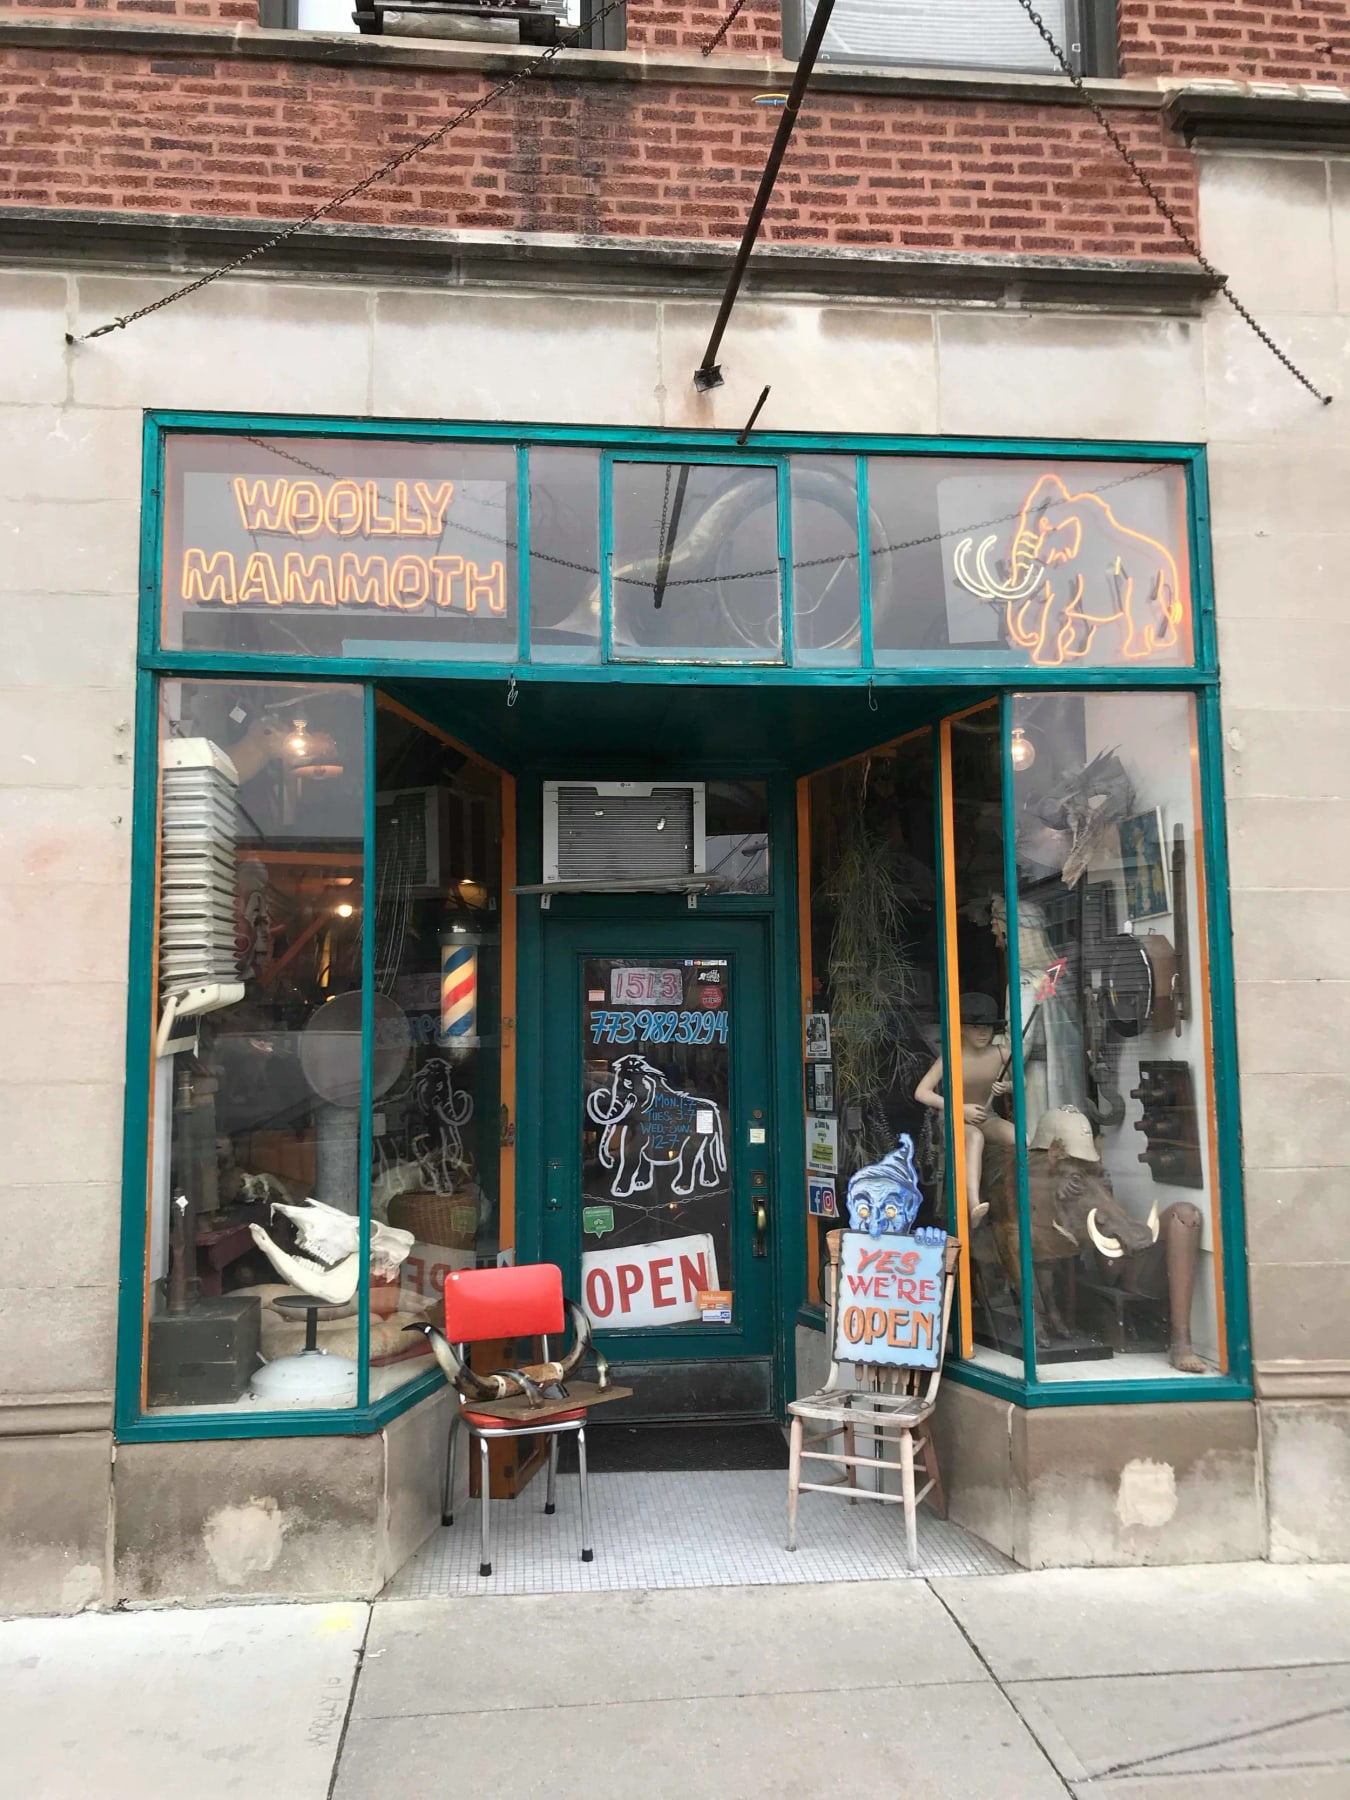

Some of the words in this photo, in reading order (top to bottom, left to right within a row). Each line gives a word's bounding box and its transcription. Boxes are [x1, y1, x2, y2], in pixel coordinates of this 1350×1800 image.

[233, 477, 454, 536] WOOLLY
[181, 548, 505, 612] MAMMOTH
[616, 972, 678, 999] 1513
[857, 1248, 921, 1275] YES
[586, 1252, 709, 1319] OPEN
[847, 1274, 937, 1305] WE'RE
[843, 1305, 935, 1350] OPEN
